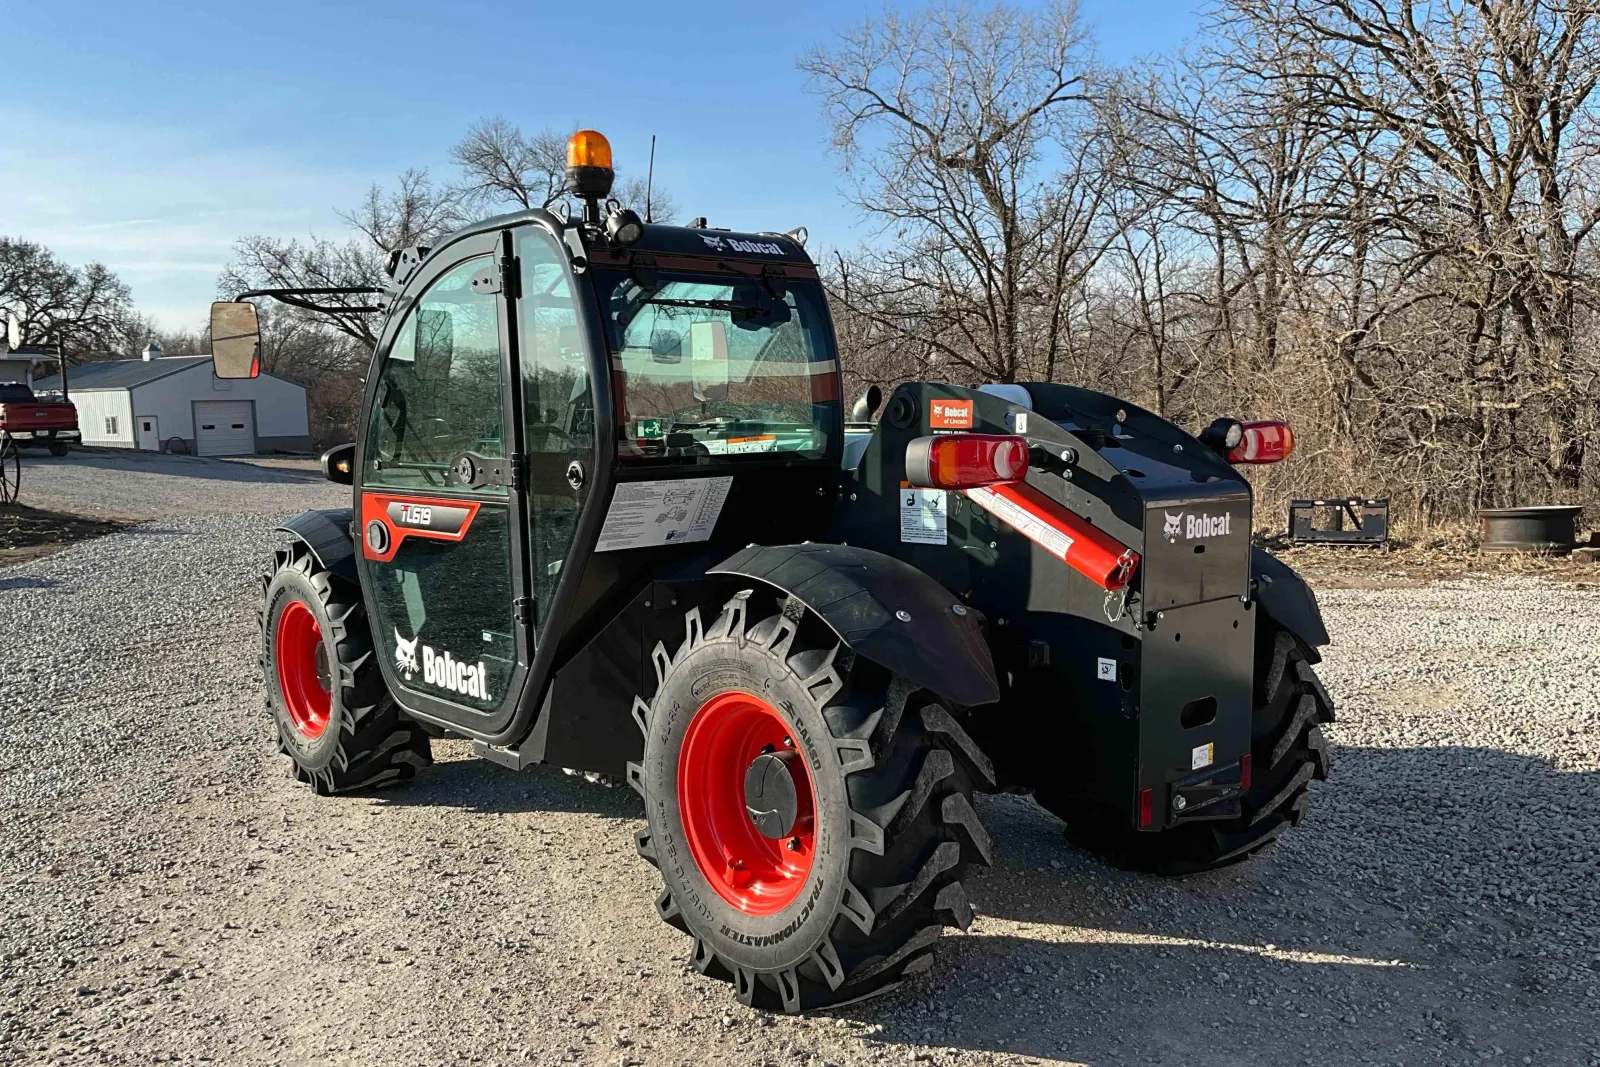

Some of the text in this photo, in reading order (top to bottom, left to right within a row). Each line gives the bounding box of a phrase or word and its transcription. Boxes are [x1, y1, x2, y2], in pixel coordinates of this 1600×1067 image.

[726, 238, 784, 255] Bobcat
[944, 406, 968, 417] Bobcat
[401, 505, 431, 525] TL619
[1186, 511, 1231, 540] Bobcat
[422, 645, 488, 701] Bobcat
[795, 716, 822, 771] CAMSO
[719, 875, 824, 948] TRACTIONMASTER
